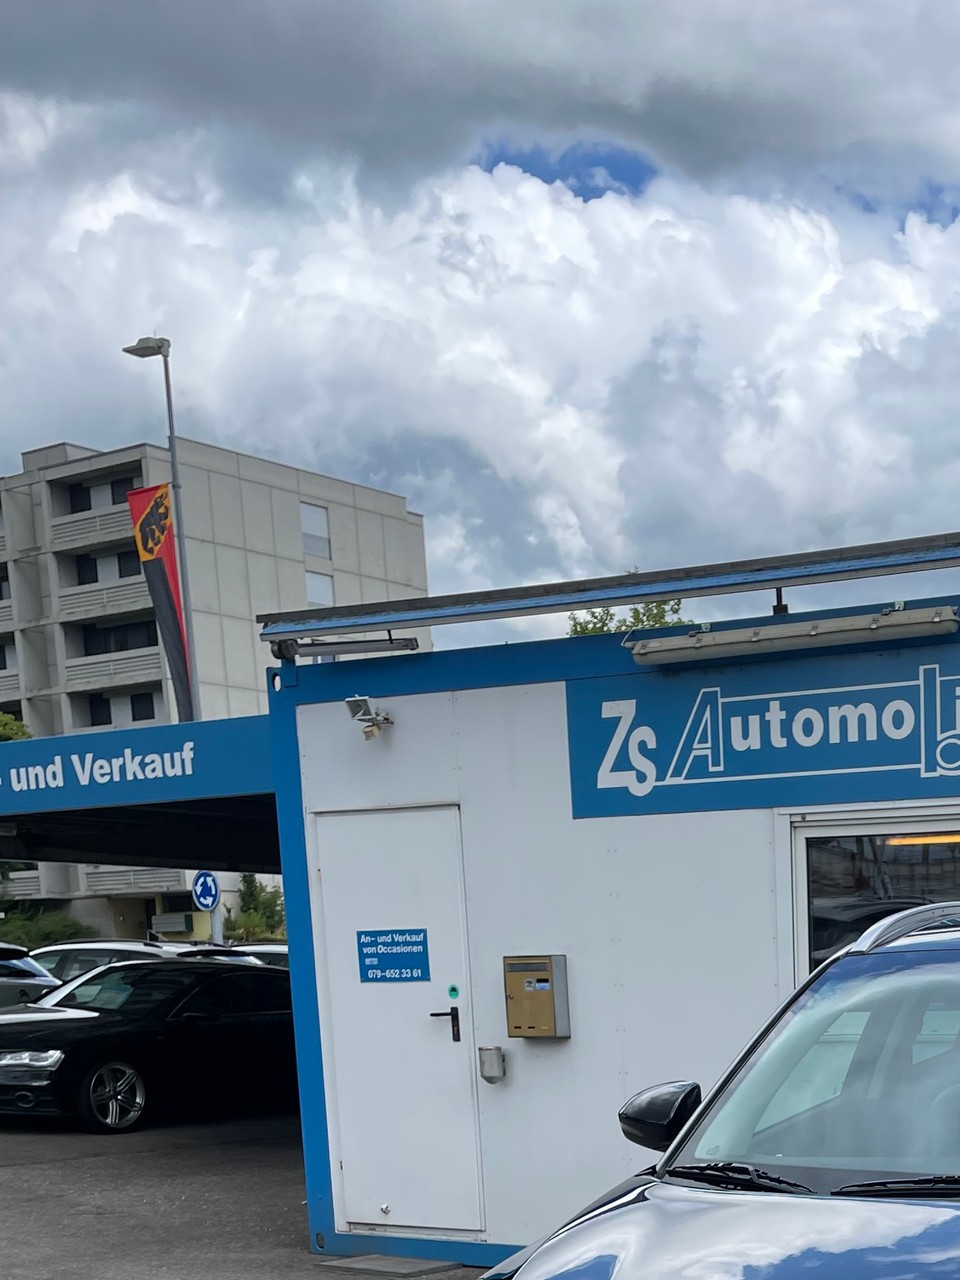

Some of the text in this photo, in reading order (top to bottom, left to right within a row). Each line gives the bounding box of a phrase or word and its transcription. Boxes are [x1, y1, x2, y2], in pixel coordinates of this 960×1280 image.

[9, 741, 194, 792] und Verkauf
[377, 933, 392, 942] und
[393, 932, 424, 942] Verkauf
[362, 944, 423, 954] von Occasionen
[401, 968, 411, 978] 33
[412, 968, 422, 978] 61
